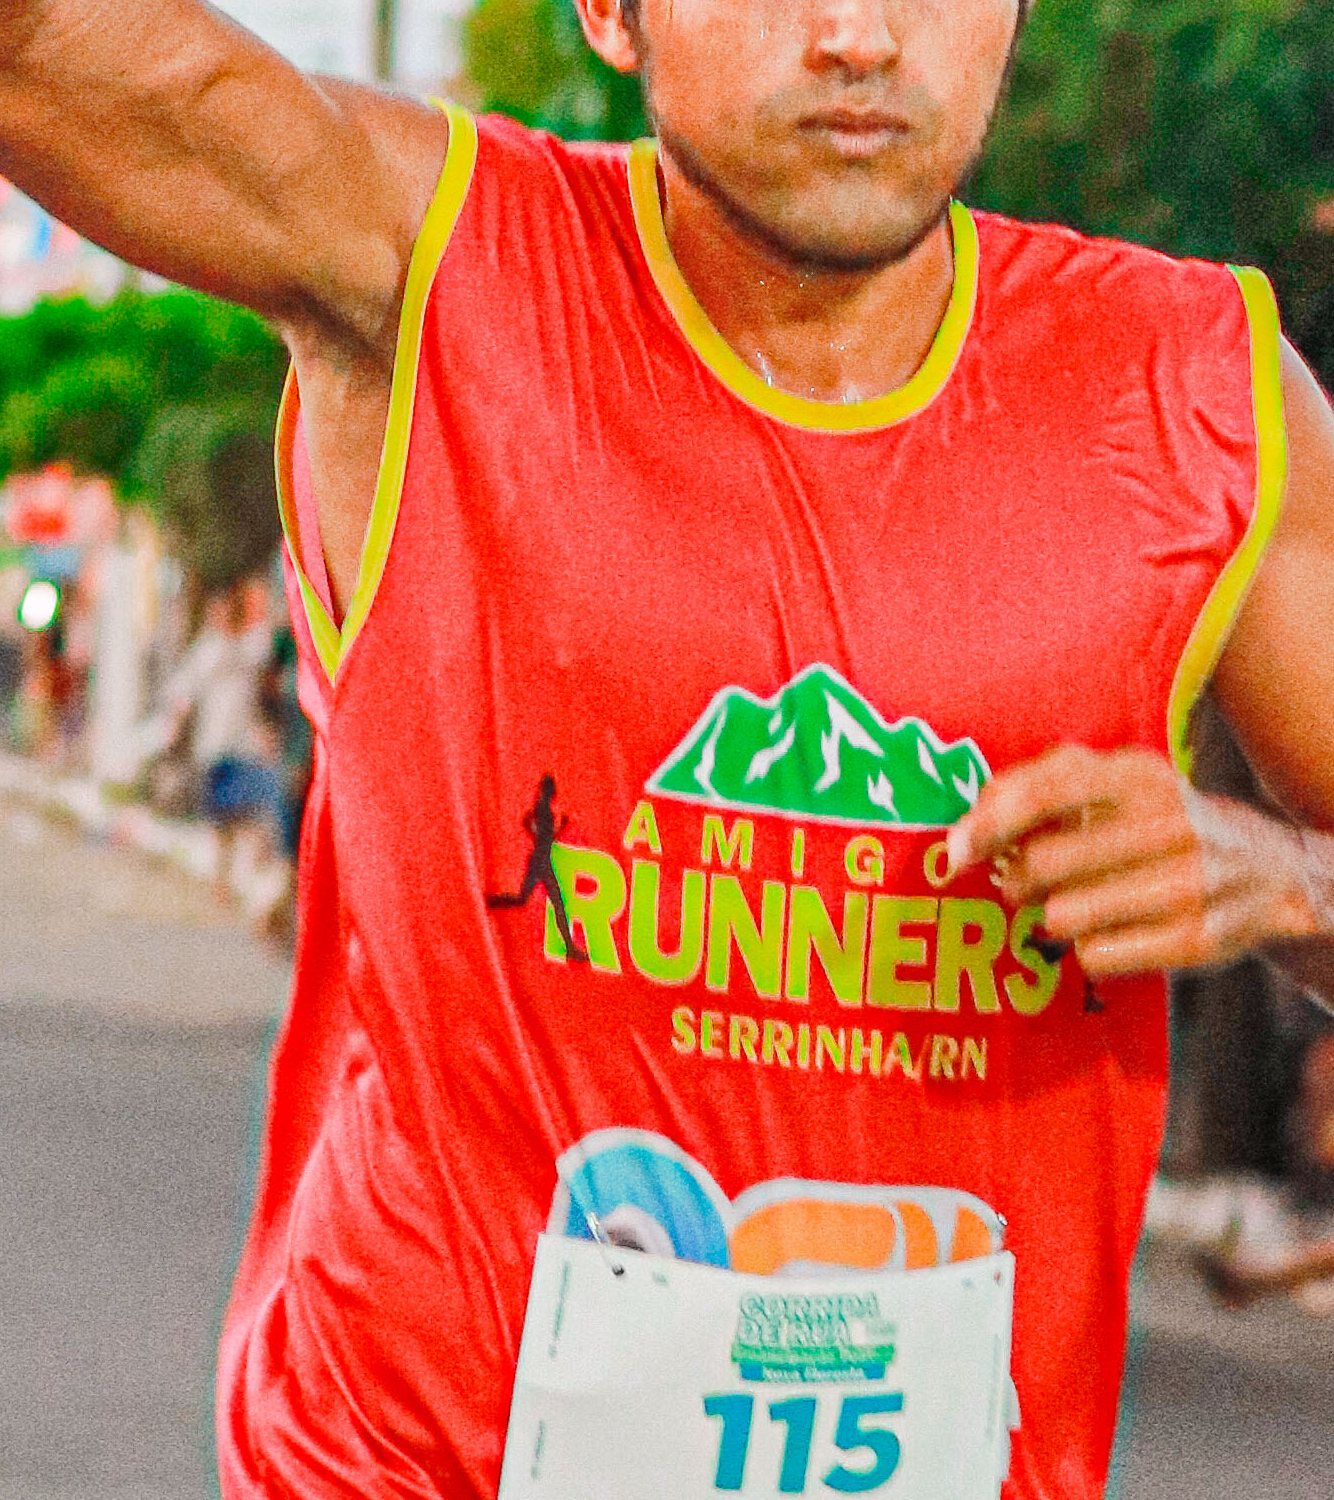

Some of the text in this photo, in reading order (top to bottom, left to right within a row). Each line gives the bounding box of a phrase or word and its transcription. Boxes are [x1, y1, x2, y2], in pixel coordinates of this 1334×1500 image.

[544, 842, 1063, 1015] RUNNERS
[670, 1006, 987, 1081] SERRINHA/RN
[703, 1393, 904, 1493] 115
